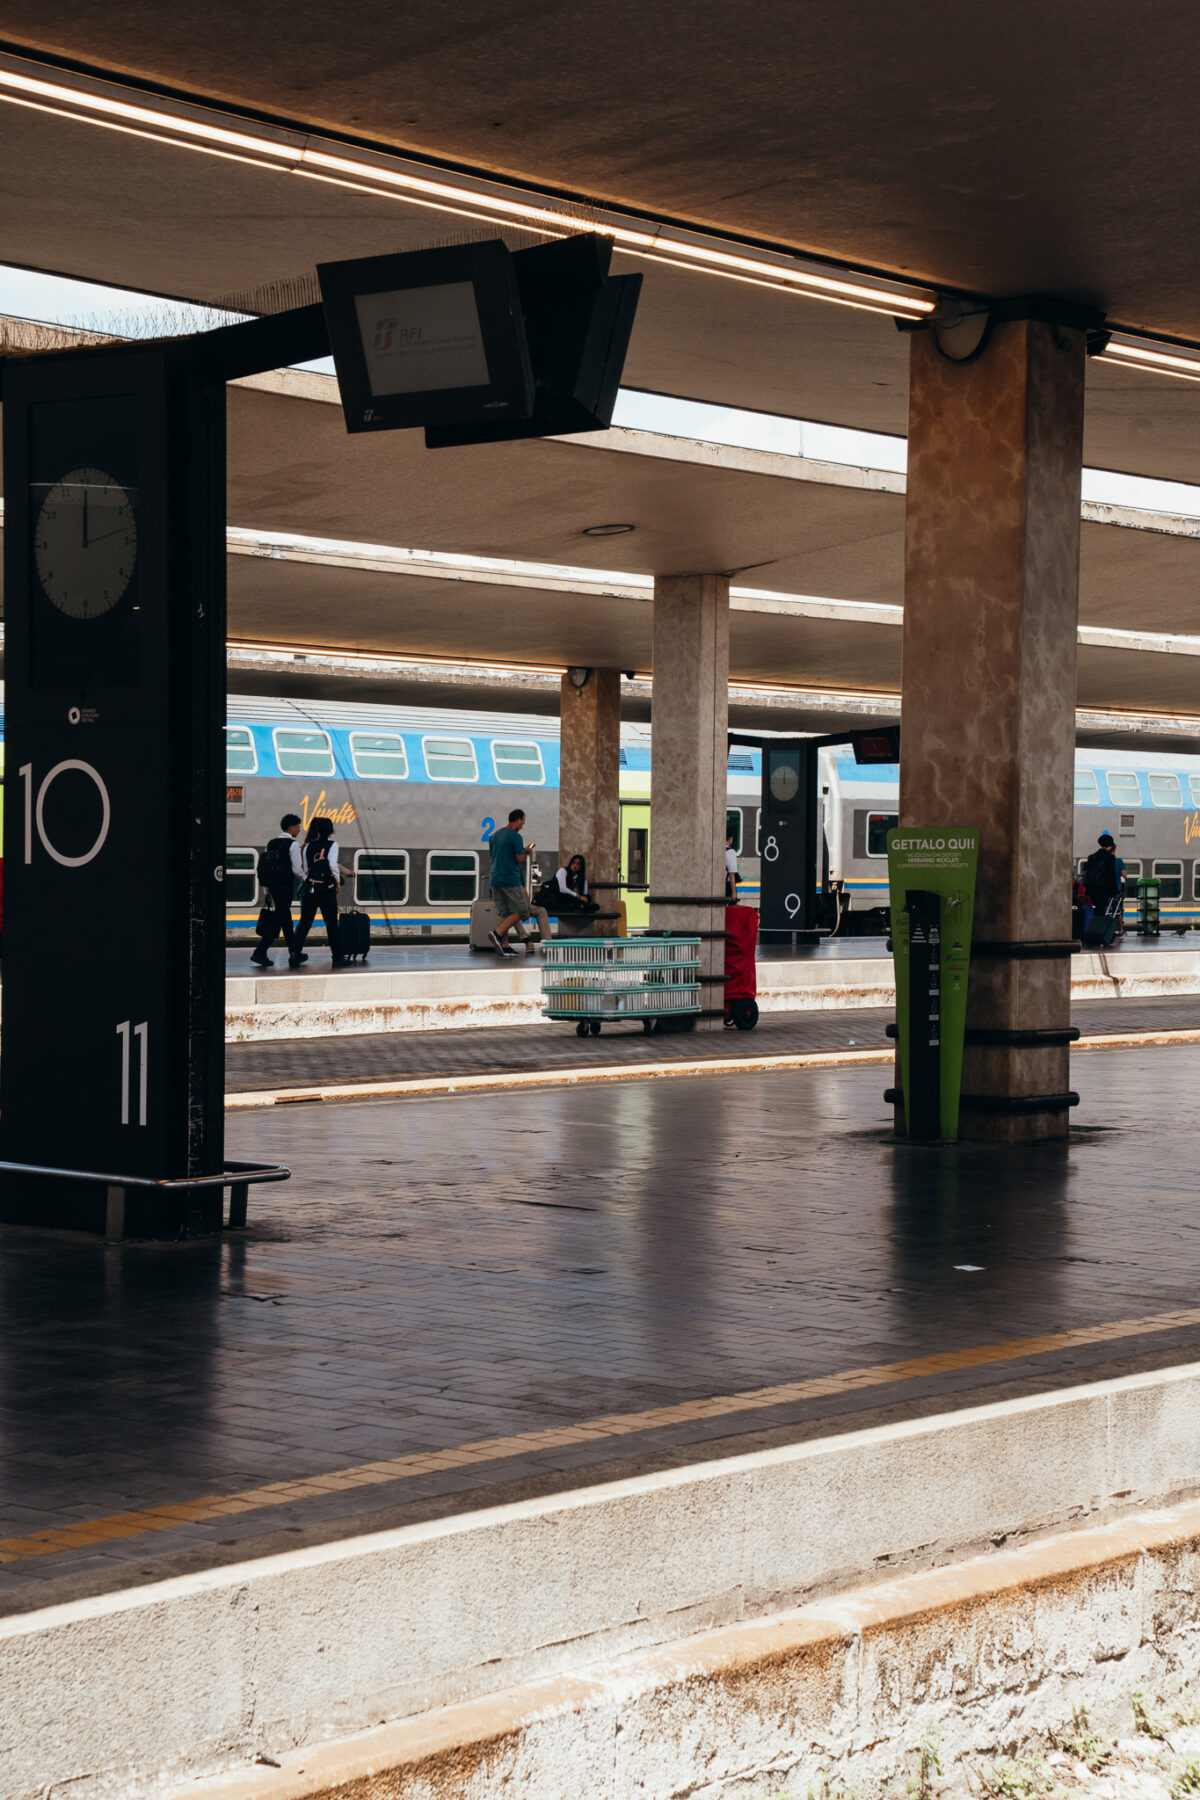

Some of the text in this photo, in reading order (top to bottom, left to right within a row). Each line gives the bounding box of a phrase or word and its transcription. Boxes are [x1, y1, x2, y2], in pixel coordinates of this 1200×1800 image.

[400, 327, 422, 341] RFI
[62, 488, 70, 496] 11
[47, 511, 57, 520] 10
[118, 506, 124, 515] 2
[18, 758, 111, 868] 10
[481, 816, 495, 842] 2
[764, 835, 779, 862] 8
[891, 838, 975, 850] GETTALO QUI!
[784, 892, 801, 919] 9
[115, 1019, 148, 1126] 11
